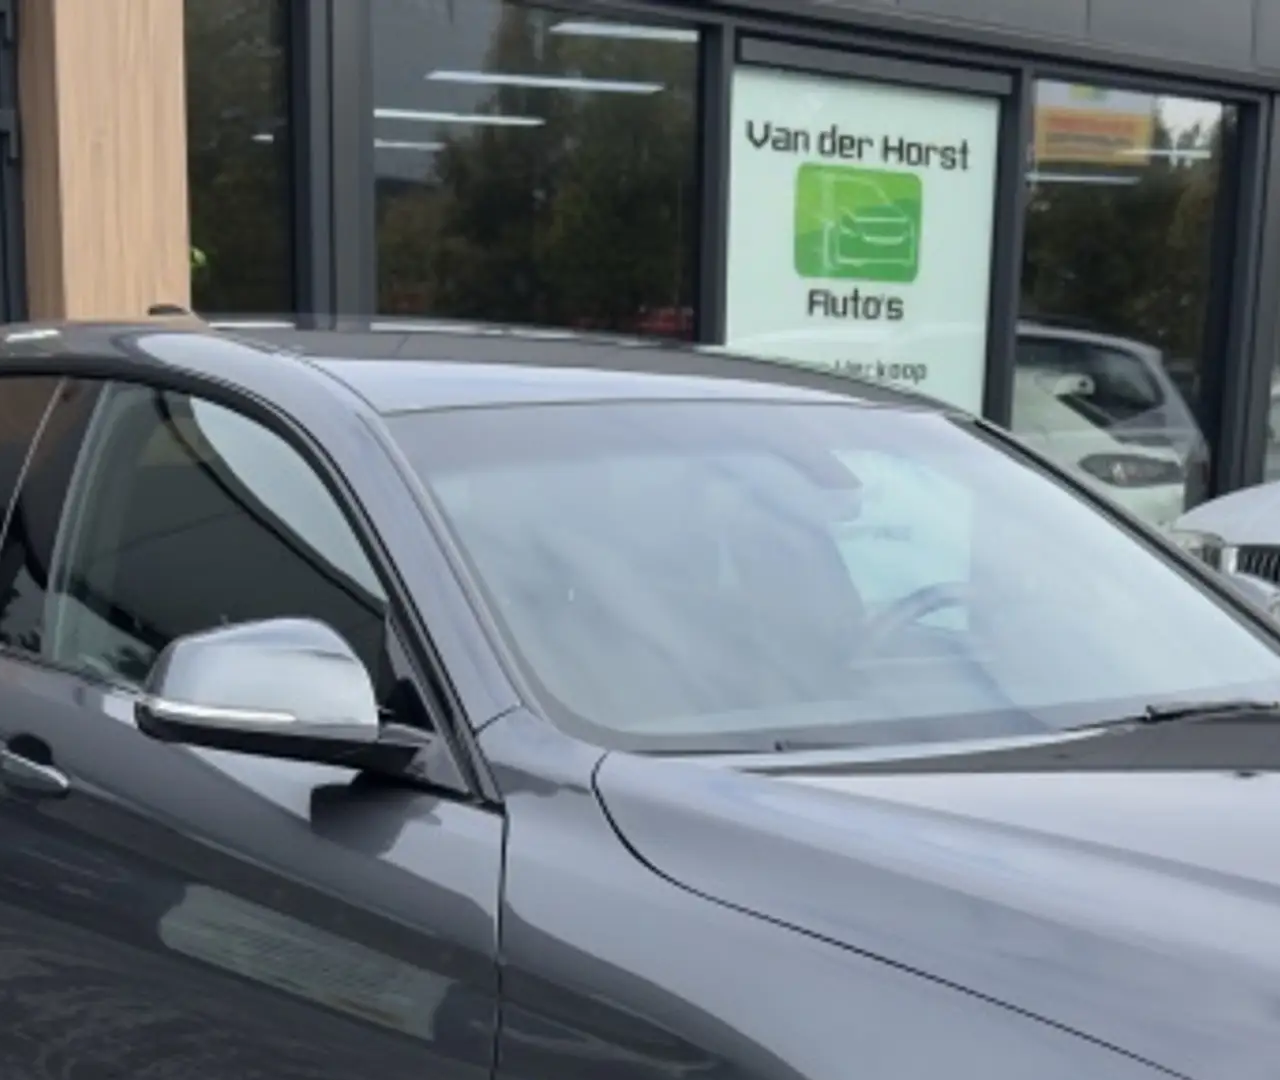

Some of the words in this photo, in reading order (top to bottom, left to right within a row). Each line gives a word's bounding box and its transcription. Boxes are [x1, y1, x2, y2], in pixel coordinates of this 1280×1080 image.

[745, 120, 810, 154] Van
[818, 124, 873, 160] der
[881, 136, 972, 171] Horst
[807, 288, 904, 321] Auto's
